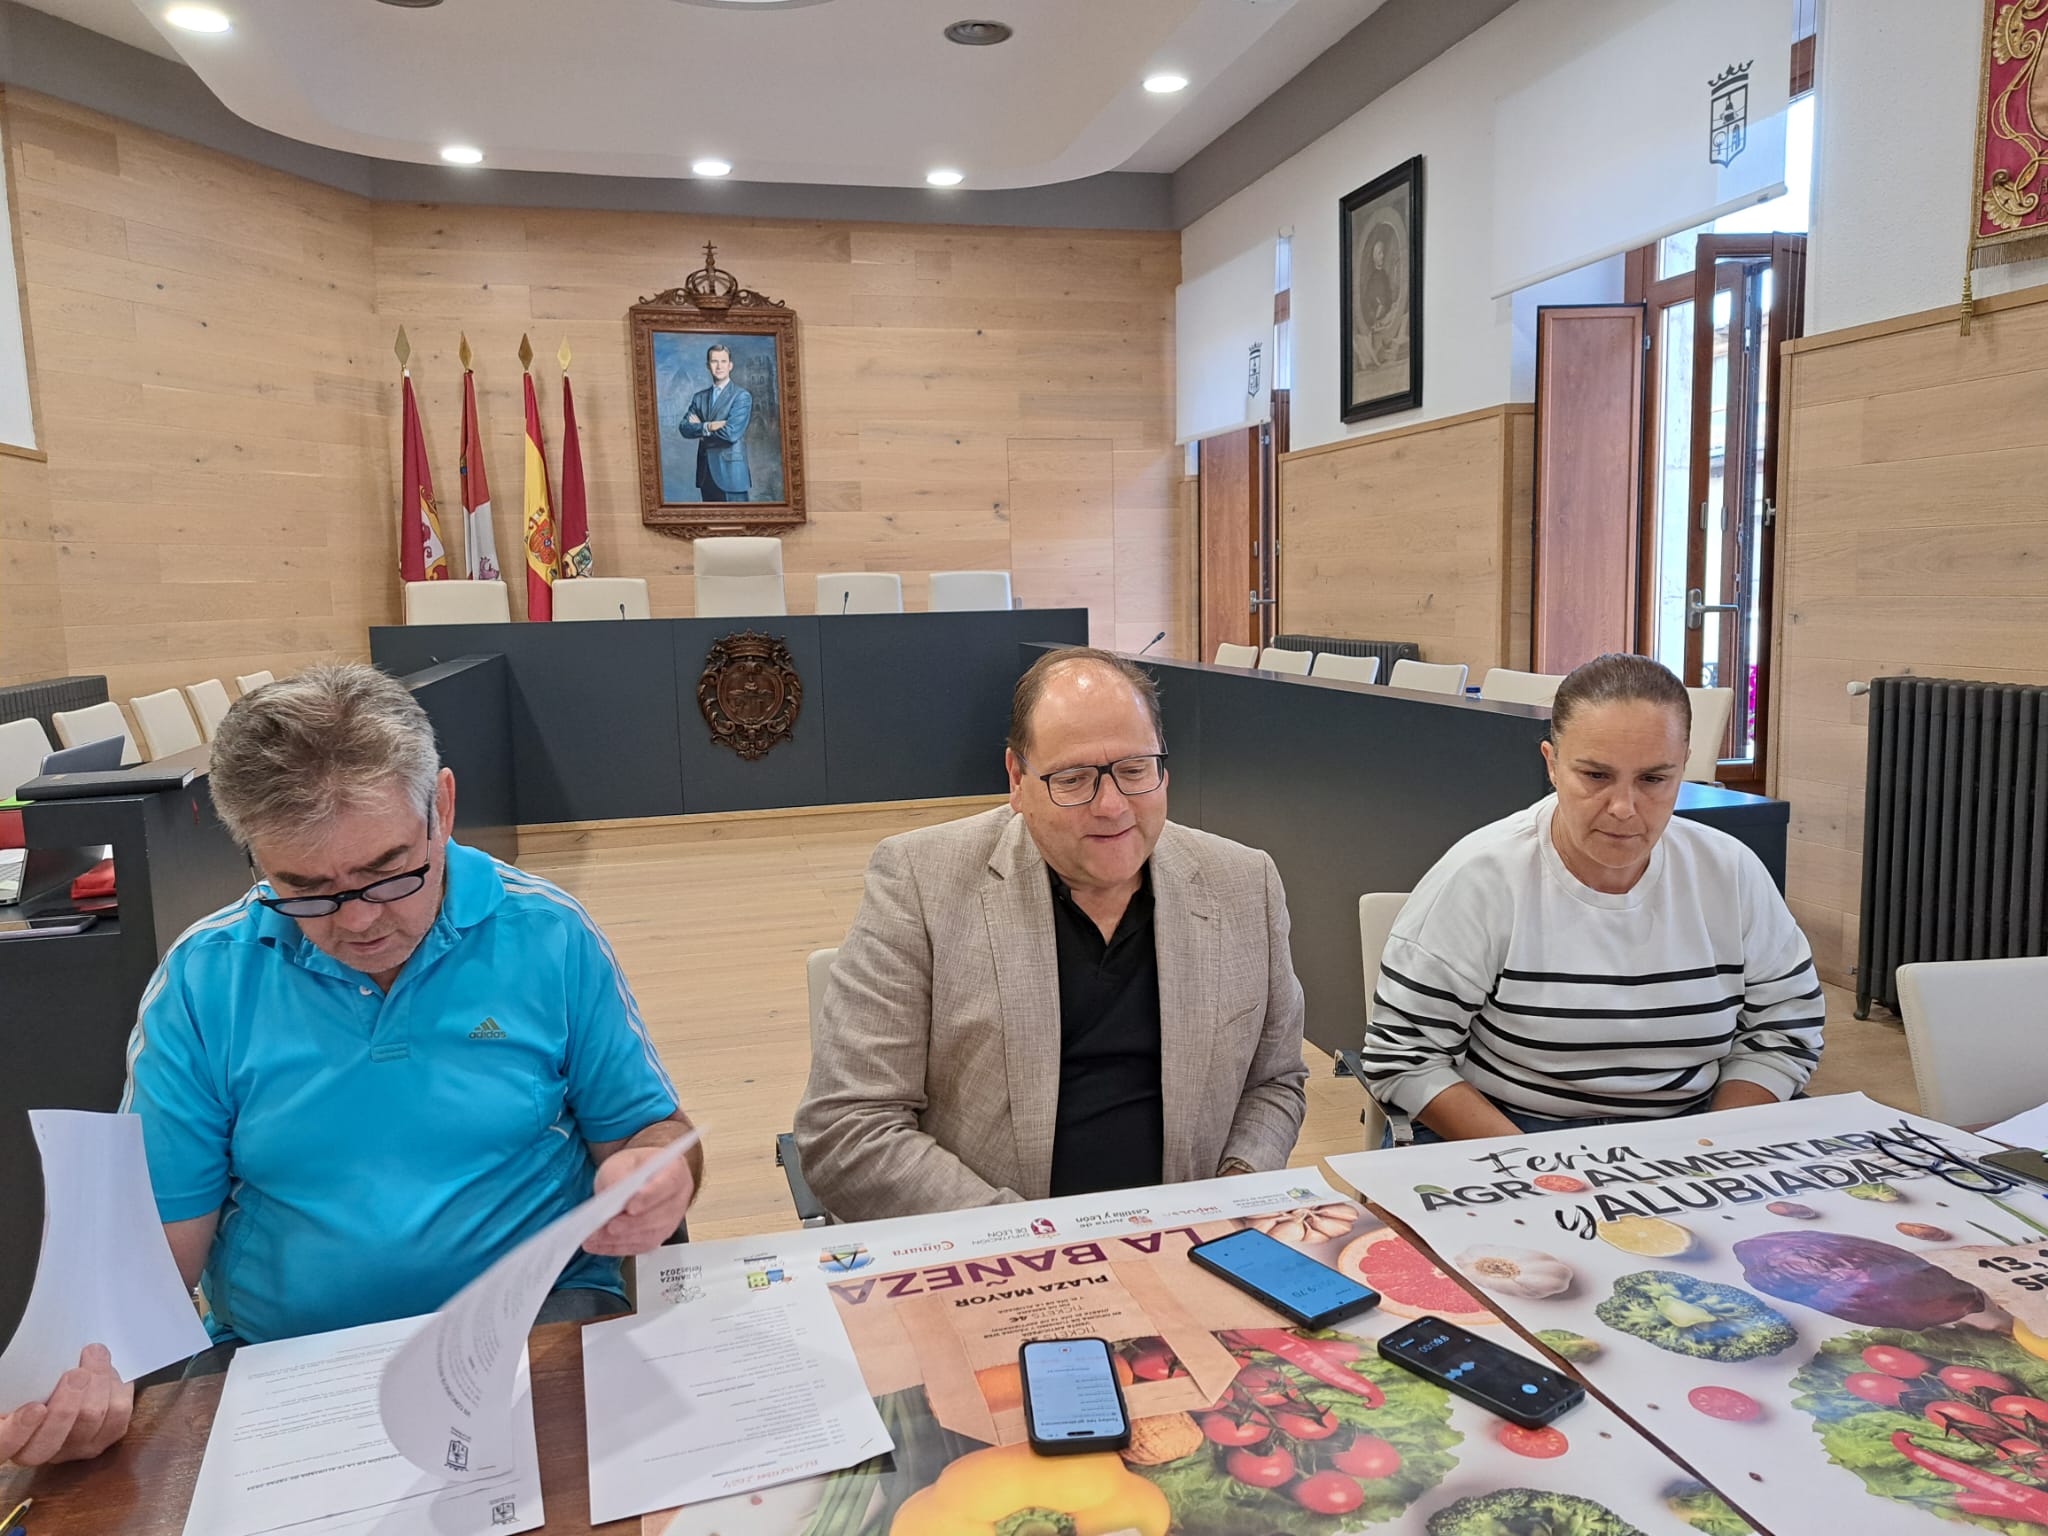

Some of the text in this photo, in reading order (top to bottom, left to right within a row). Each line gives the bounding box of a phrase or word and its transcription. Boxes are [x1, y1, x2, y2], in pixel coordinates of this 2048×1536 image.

[469, 1031, 507, 1039] adidas
[1469, 1144, 1645, 1178] Feria
[1593, 1158, 1907, 1223] ALUBIADA
[1075, 1214, 1102, 1223] León
[1113, 1207, 1150, 1218] Castilla
[1095, 1217, 1124, 1226] Junta
[972, 1232, 1030, 1244] DIPUTACIÓN
[987, 1228, 1013, 1238] LEÓN
[893, 1240, 955, 1257] Cámara
[827, 1227, 1206, 1305] LA BAÑEZA
[955, 1274, 1110, 1308] PLAZA MAYOR
[1008, 1304, 1083, 1323] TICKETS 4€
[1043, 1326, 1096, 1341] TICKETS
